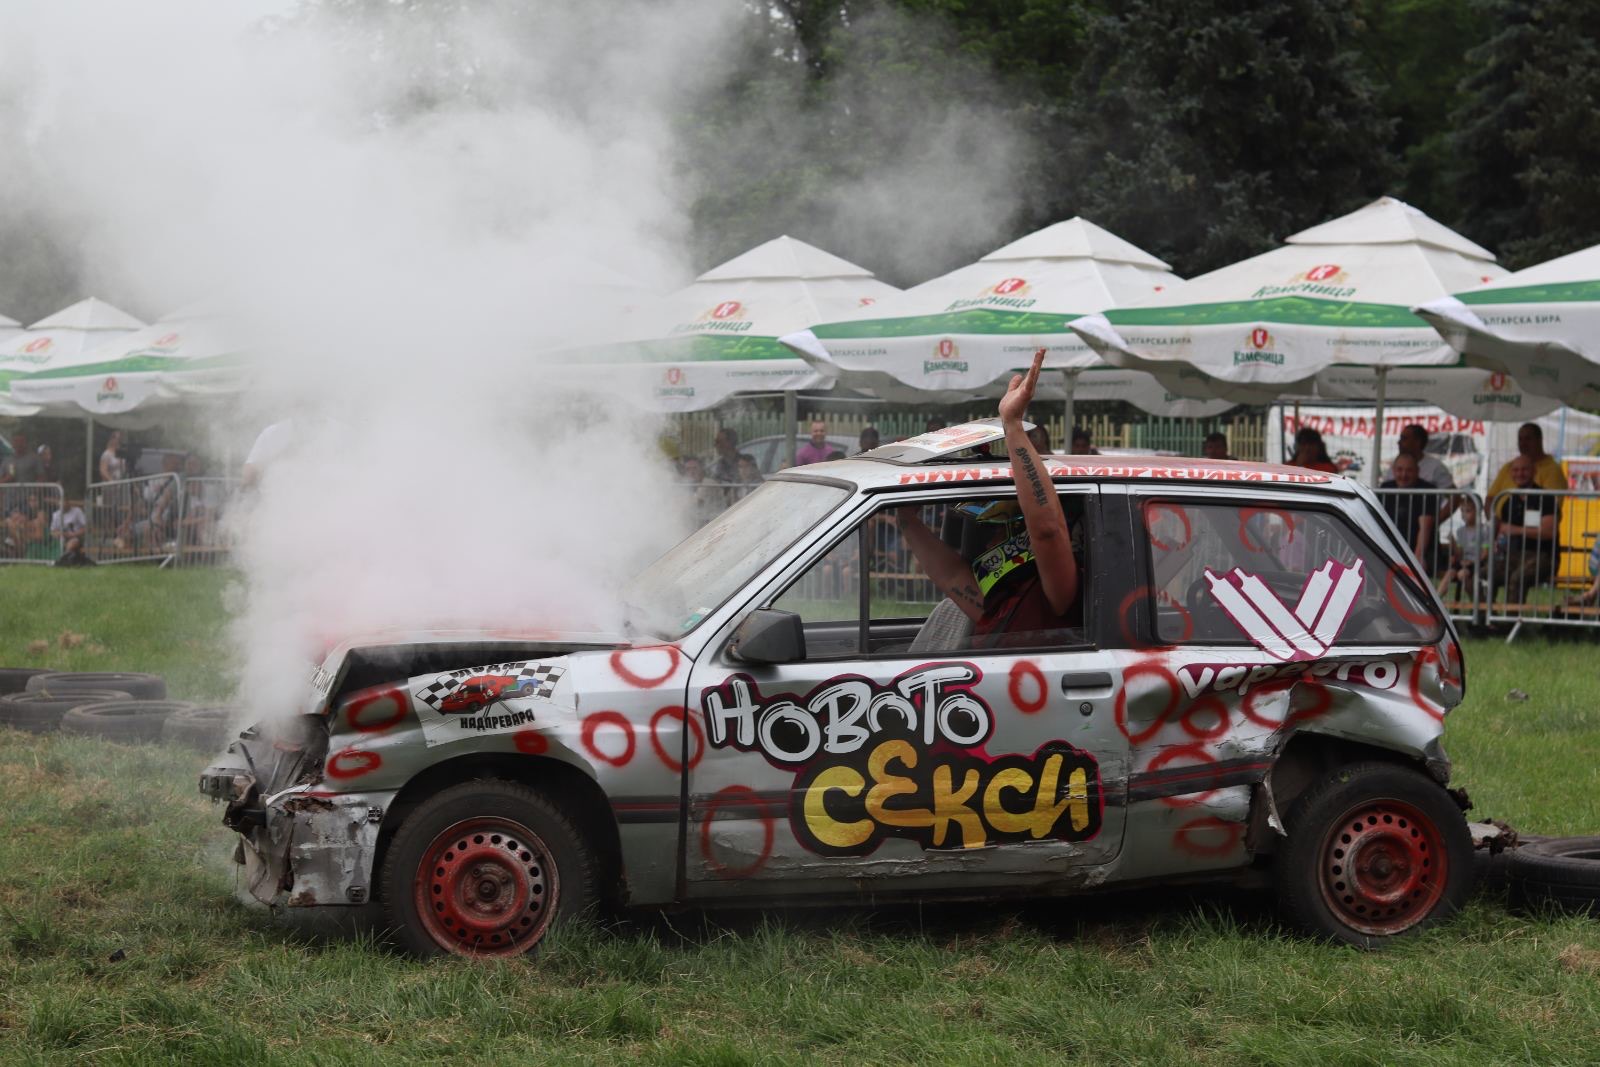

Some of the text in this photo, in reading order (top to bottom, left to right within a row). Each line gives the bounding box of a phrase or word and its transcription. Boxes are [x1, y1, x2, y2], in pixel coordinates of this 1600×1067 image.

[1233, 351, 1285, 366] Каменица
[460, 709, 535, 731] НАДПРЕВАРА
[803, 739, 1090, 849] СЕКСИ
